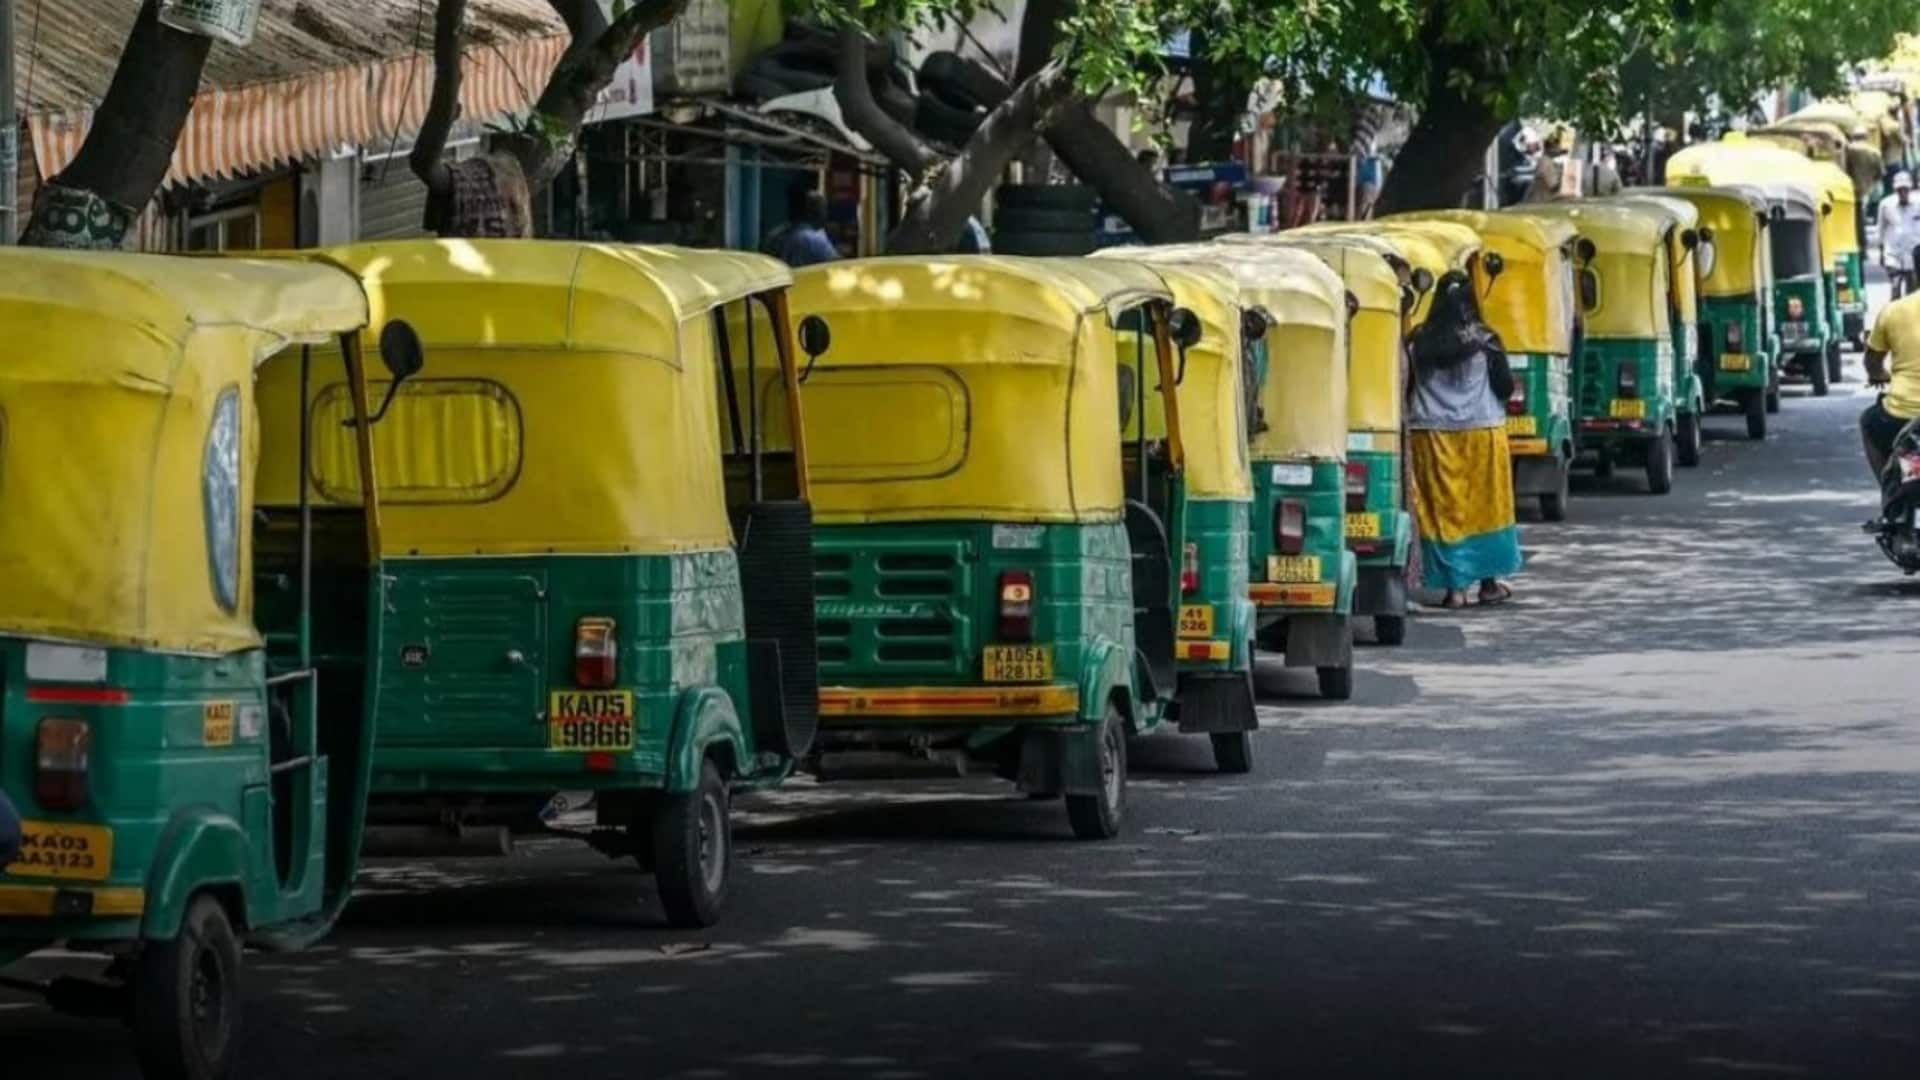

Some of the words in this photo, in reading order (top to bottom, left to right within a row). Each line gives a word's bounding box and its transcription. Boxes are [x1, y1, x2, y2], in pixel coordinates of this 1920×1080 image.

[995, 647, 1044, 662] KA05A
[559, 695, 625, 717] KA05
[563, 721, 630, 746] 9866
[21, 832, 89, 851] KA03
